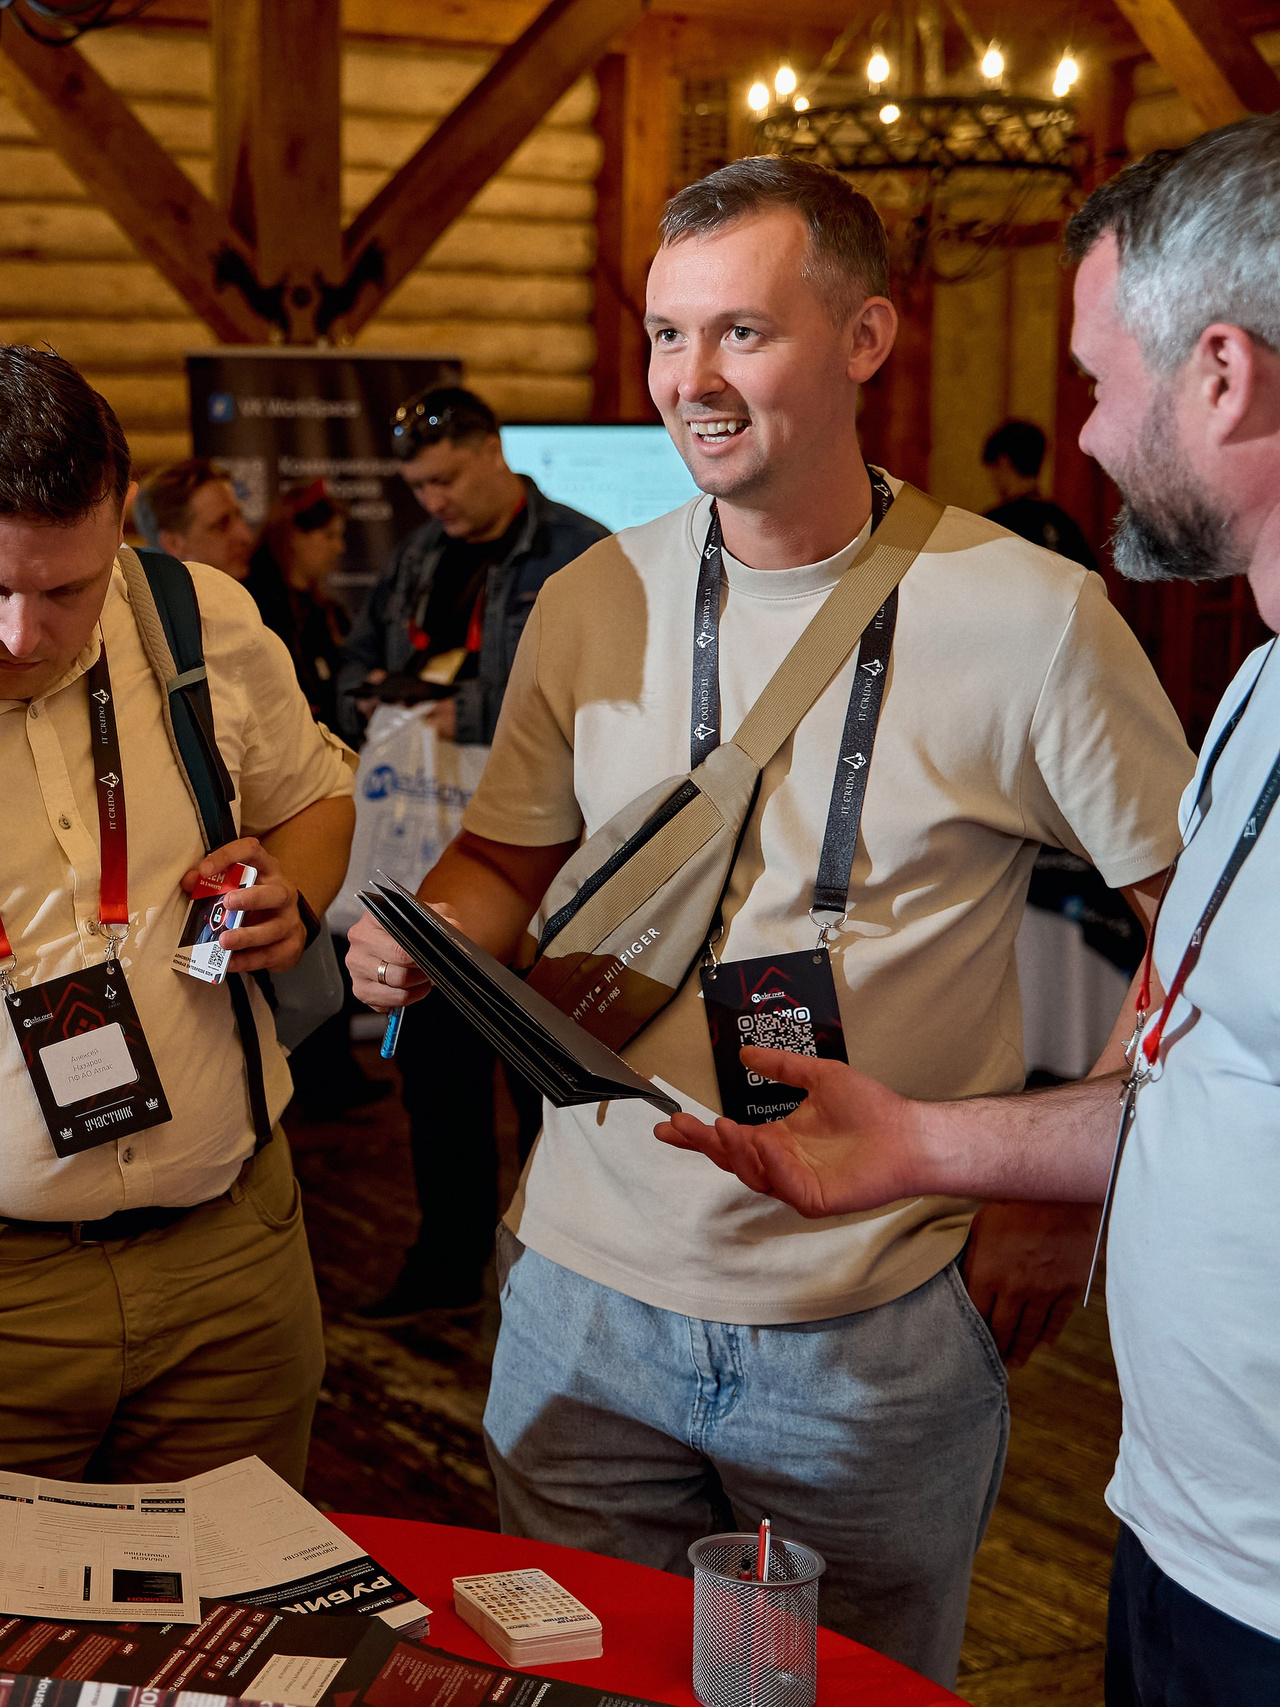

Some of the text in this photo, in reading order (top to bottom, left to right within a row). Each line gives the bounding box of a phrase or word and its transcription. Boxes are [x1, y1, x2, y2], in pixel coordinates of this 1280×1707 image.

[874, 619, 883, 630] IT
[858, 678, 873, 721] IT CREDO
[102, 736, 108, 744] IT
[841, 771, 856, 815] IT CREDO
[107, 790, 117, 830] IT CREDO
[570, 927, 661, 1024] MMY HILFIGER
[598, 988, 621, 1014] EST. 1985
[70, 1048, 99, 1063] Алексей
[68, 1072, 80, 1083] ПФ
[94, 1063, 113, 1076] Атлас
[73, 1058, 102, 1072] Назаров
[123, 1550, 170, 1558] ПРИМЕНЕНИЯ
[282, 1540, 334, 1561] ПРЕИМУЩЕСТВА
[302, 1545, 339, 1561] КЛЮЧЕВЫЕ
[251, 1610, 264, 1624] ECS
[238, 1623, 253, 1639] DENY
[227, 1639, 240, 1653] DNS
[214, 1652, 229, 1670] SPLIT
[172, 1674, 186, 1690] HTTP
